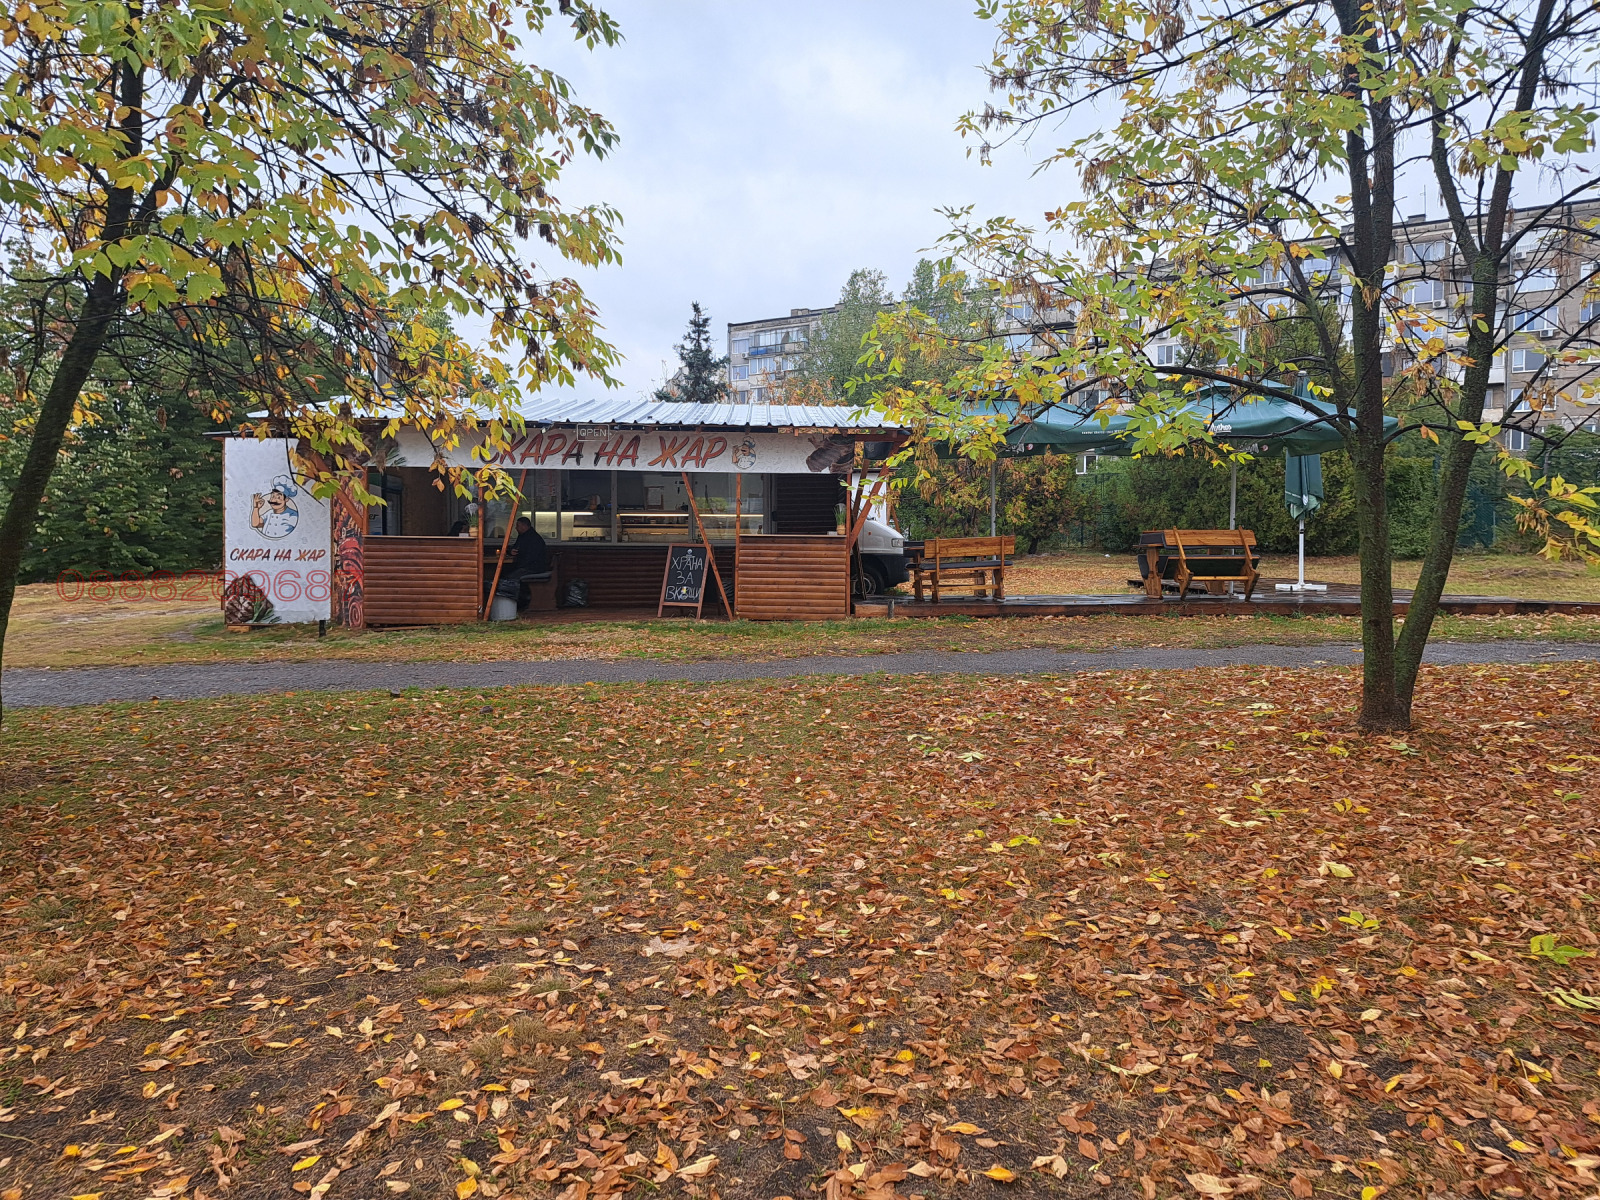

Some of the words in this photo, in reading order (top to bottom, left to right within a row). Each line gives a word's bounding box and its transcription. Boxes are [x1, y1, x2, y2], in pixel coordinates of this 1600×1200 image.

[580, 428, 607, 437] OPEN
[593, 434, 641, 467] НА
[648, 436, 728, 468] ЖАР
[230, 548, 270, 562] СКАРА
[273, 548, 292, 562] НА
[295, 548, 326, 562] ЖАР
[671, 556, 703, 570] ХРАНА
[677, 571, 693, 584] ЗА
